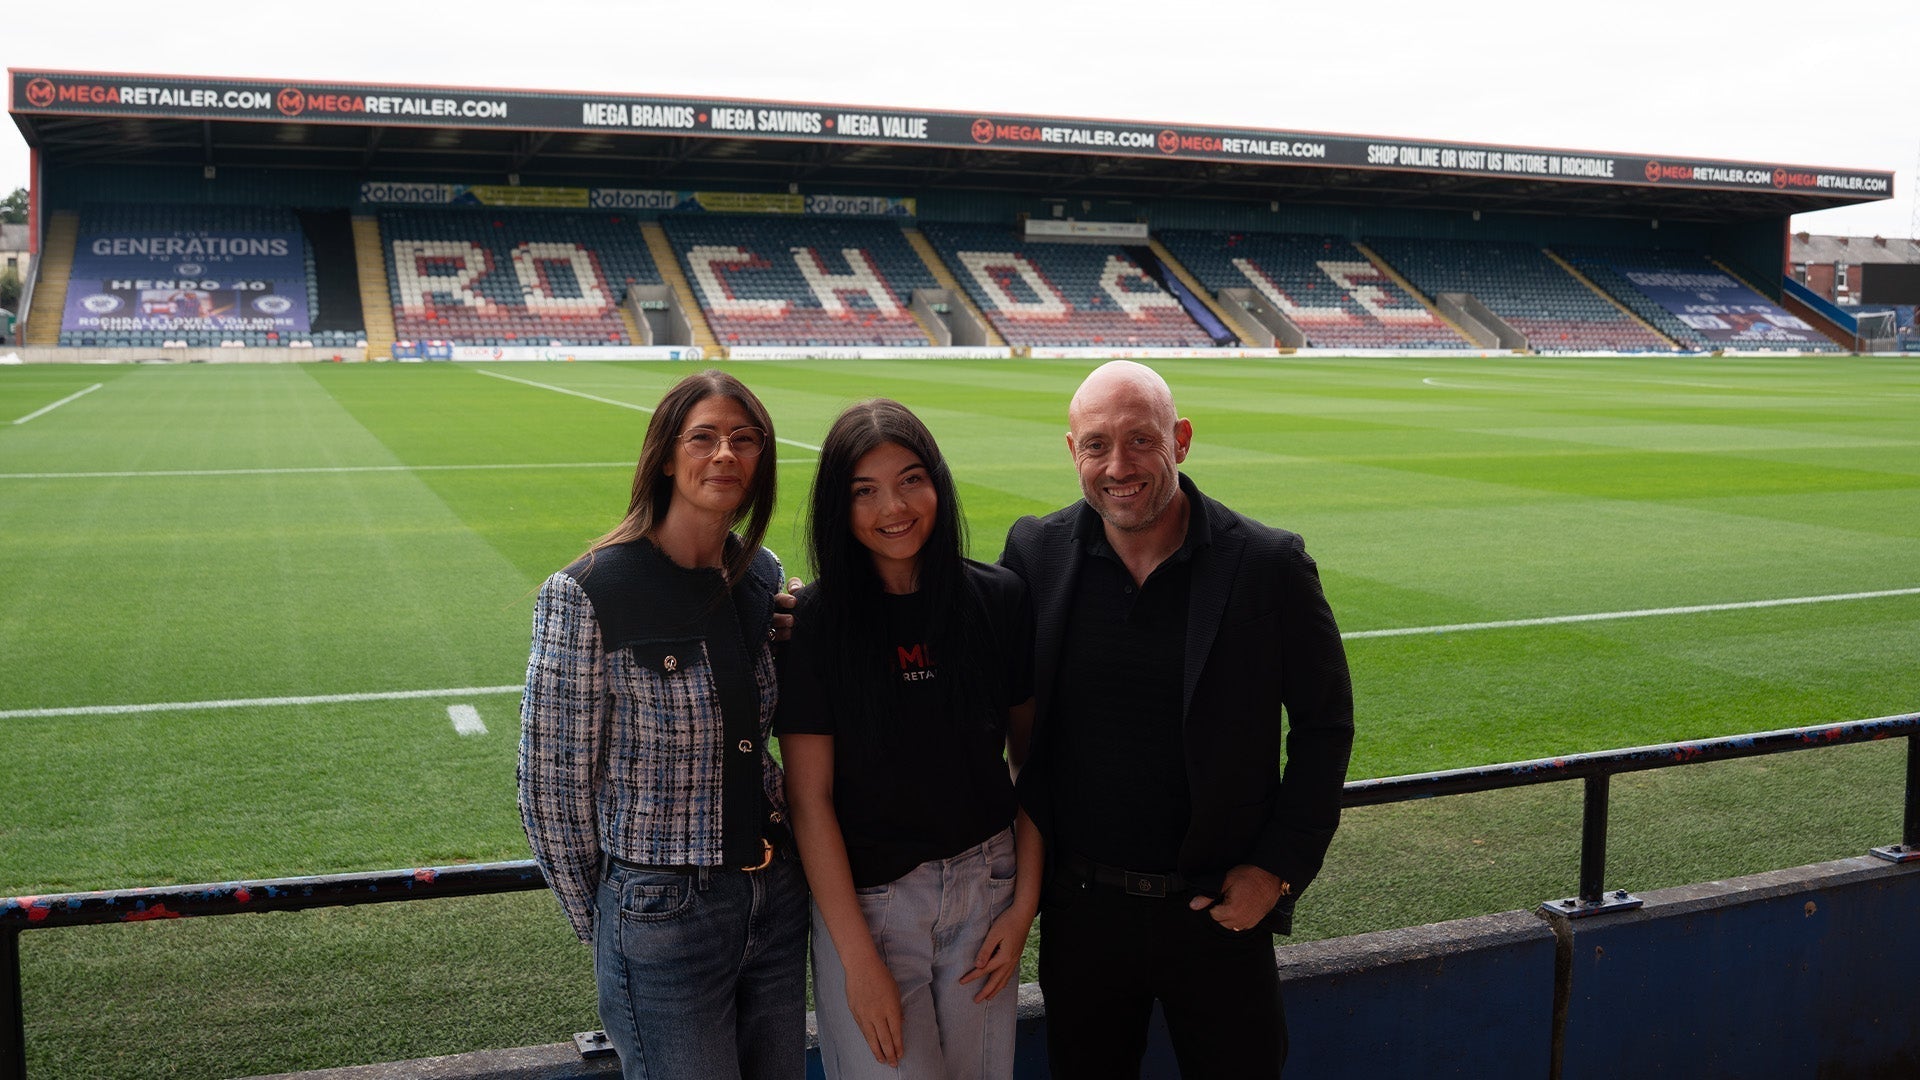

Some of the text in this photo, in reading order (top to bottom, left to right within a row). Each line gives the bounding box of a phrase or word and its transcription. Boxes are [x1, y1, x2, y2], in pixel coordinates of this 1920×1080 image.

[59, 85, 271, 109] MEGARETAILER.COM
[308, 94, 507, 118] MEGARETAILER.COM
[583, 103, 928, 139] MEGA BRANDS MEGA SAVINGS MEGA VALUE
[996, 125, 1154, 148] MEGARETAILER.COM
[1181, 136, 1325, 158] MEGARETAILER.COM
[1368, 145, 1614, 177] SHOP ONLINE OR VISIT US INSTORE IN ROCHDALE
[1662, 166, 1771, 184] MEGARETAILER.COM
[1788, 173, 1886, 191] MEGARETAILER.COM
[361, 183, 446, 203] Rotonair
[591, 188, 673, 209] Rotonair
[805, 195, 882, 214] Rotonair
[92, 238, 288, 256] GENERATIONS
[111, 280, 266, 291] HENDO 40
[903, 670, 937, 681] RETA
